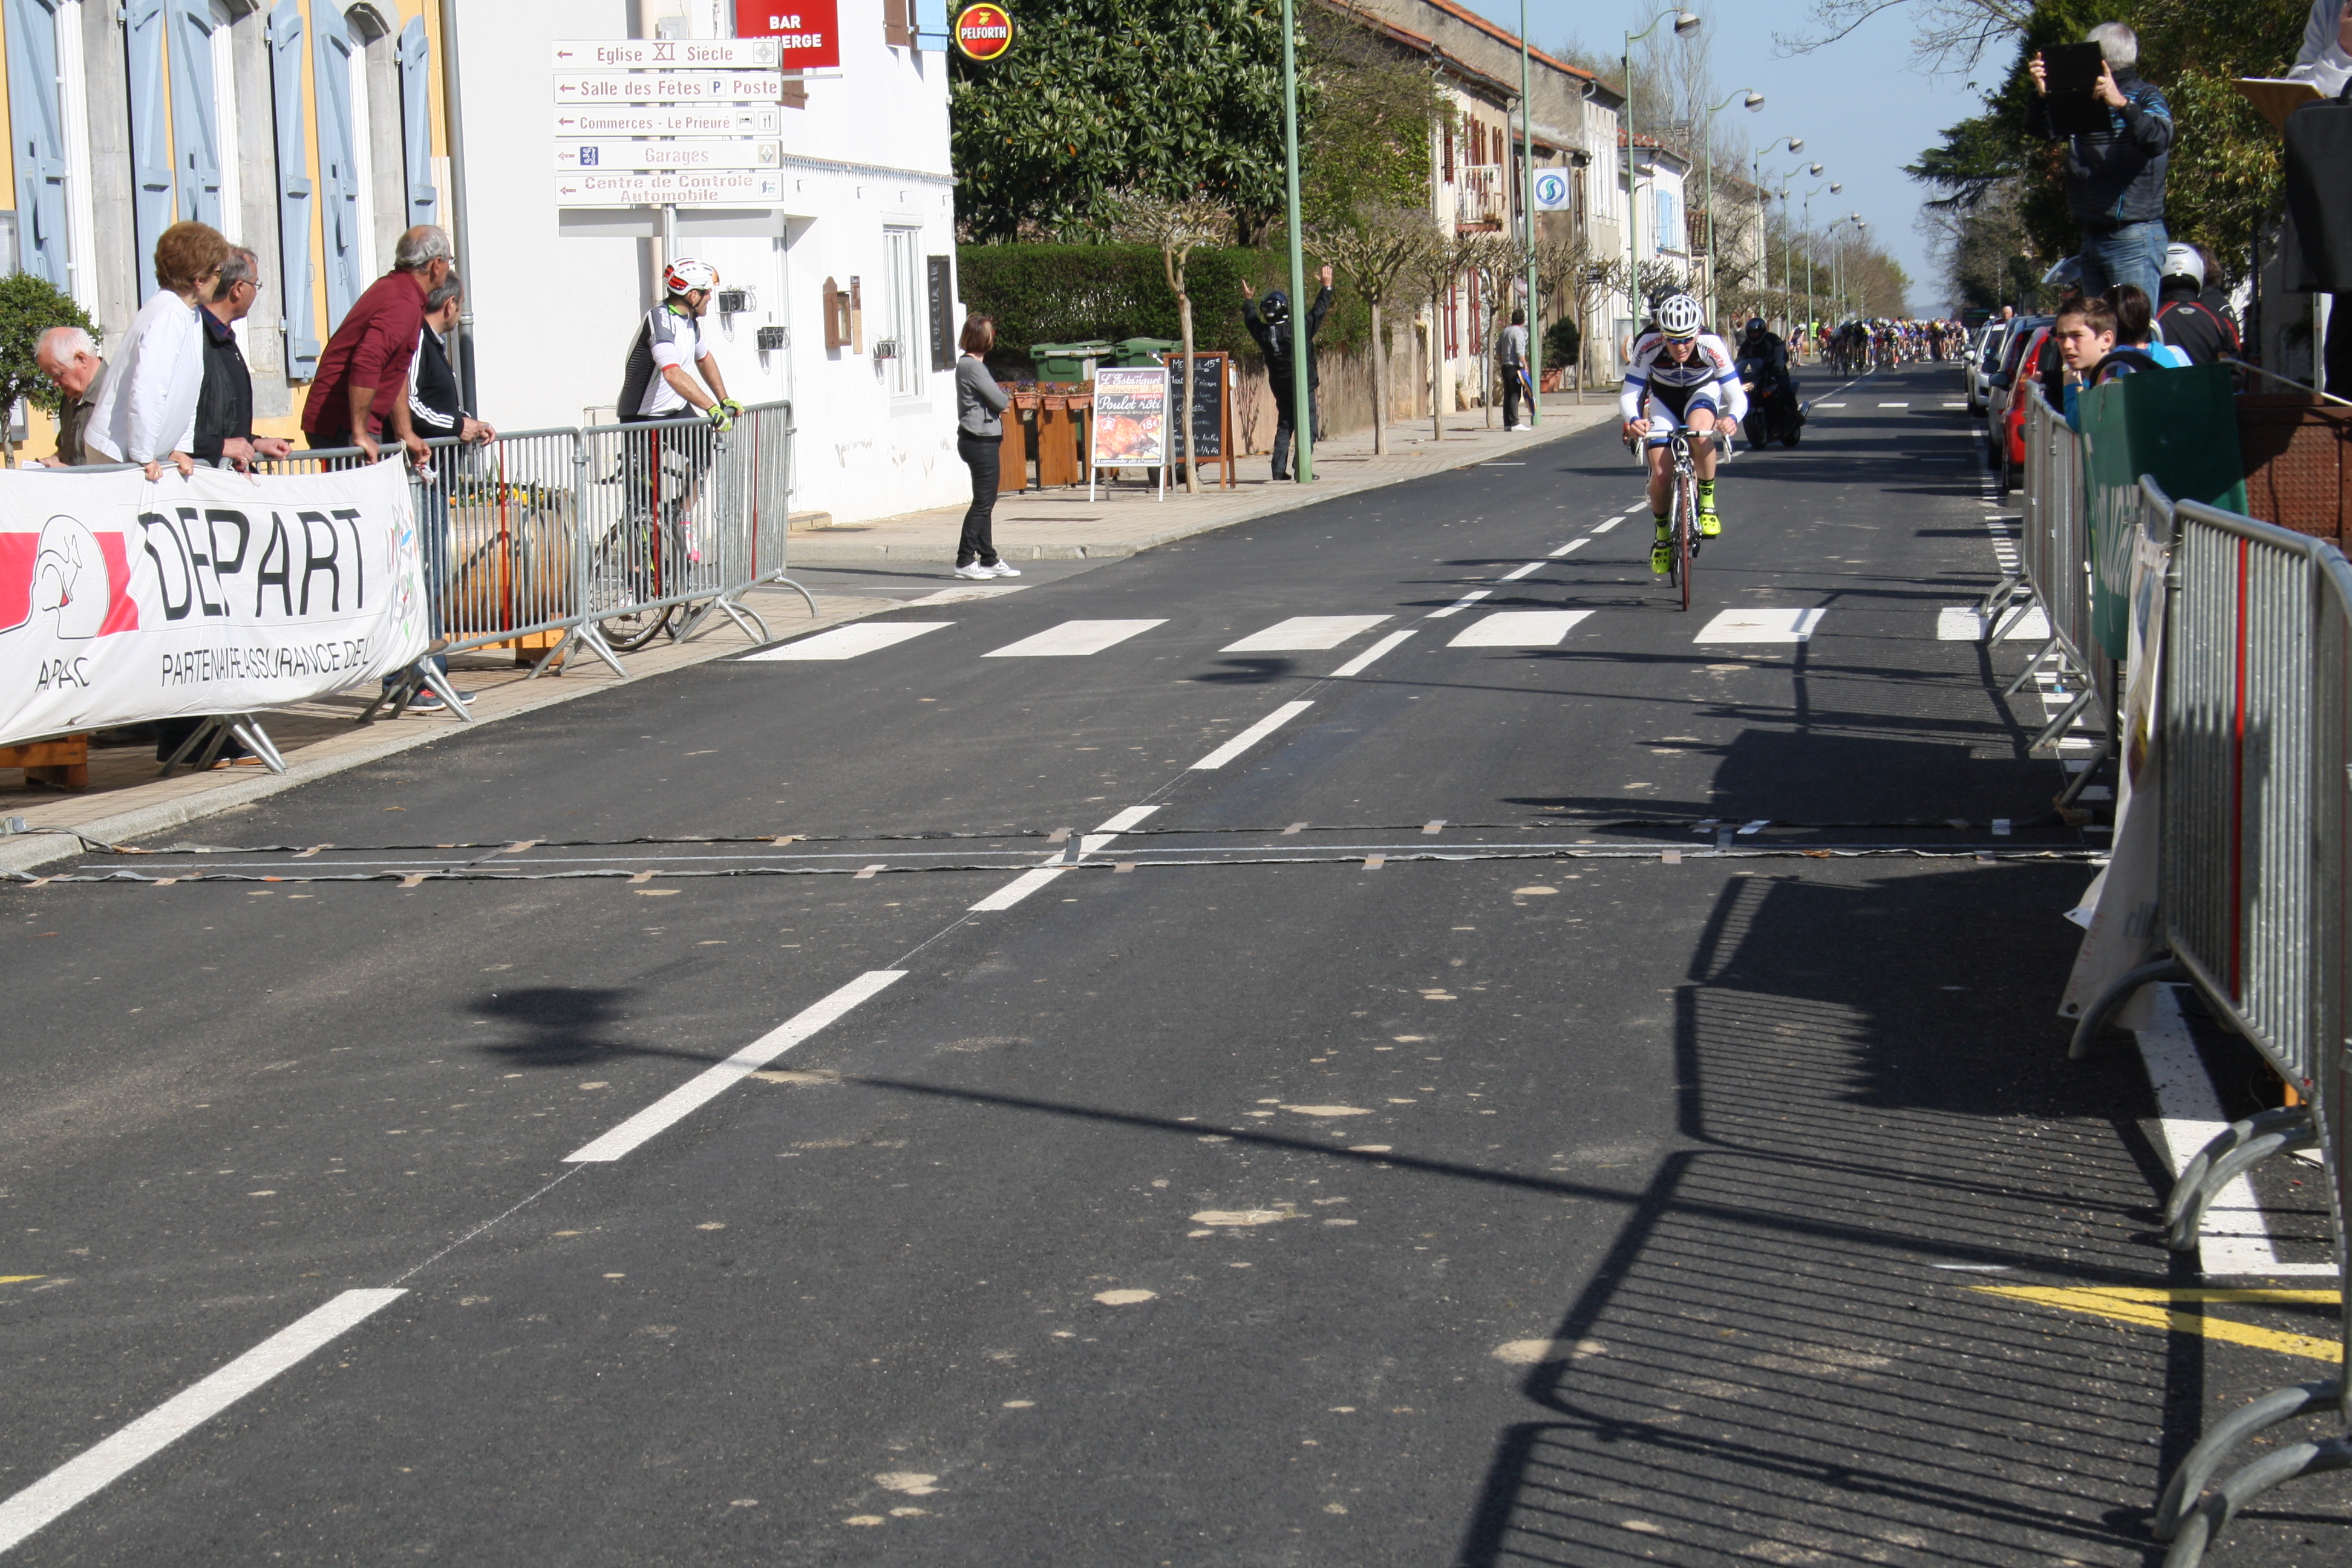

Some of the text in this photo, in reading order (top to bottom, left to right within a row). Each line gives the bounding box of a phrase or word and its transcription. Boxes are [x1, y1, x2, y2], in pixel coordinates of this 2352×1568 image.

[769, 15, 801, 29] BAR
[961, 27, 1007, 39] PELFORTH
[597, 42, 733, 65] Eglise XI Siécle
[580, 81, 618, 96] Salle
[625, 81, 652, 95] des
[658, 79, 701, 95] Fêtes
[733, 80, 777, 94] Poste
[580, 117, 653, 129] Commerces
[668, 117, 682, 129] Le
[685, 115, 730, 129] Prieuré
[645, 148, 709, 165] Garages
[584, 177, 644, 189] Centre
[652, 176, 671, 188] de
[620, 189, 719, 202] Automobile
[1101, 373, 1163, 390] L'Estanquet
[1100, 385, 1161, 393] Restaurant Bar
[1098, 396, 1161, 410] Poulet rôti
[1142, 419, 1158, 430] 18€
[138, 507, 362, 621] DEPART
[243, 642, 341, 679] ASSURANCE
[343, 638, 365, 670] DE
[34, 657, 90, 693] APAC
